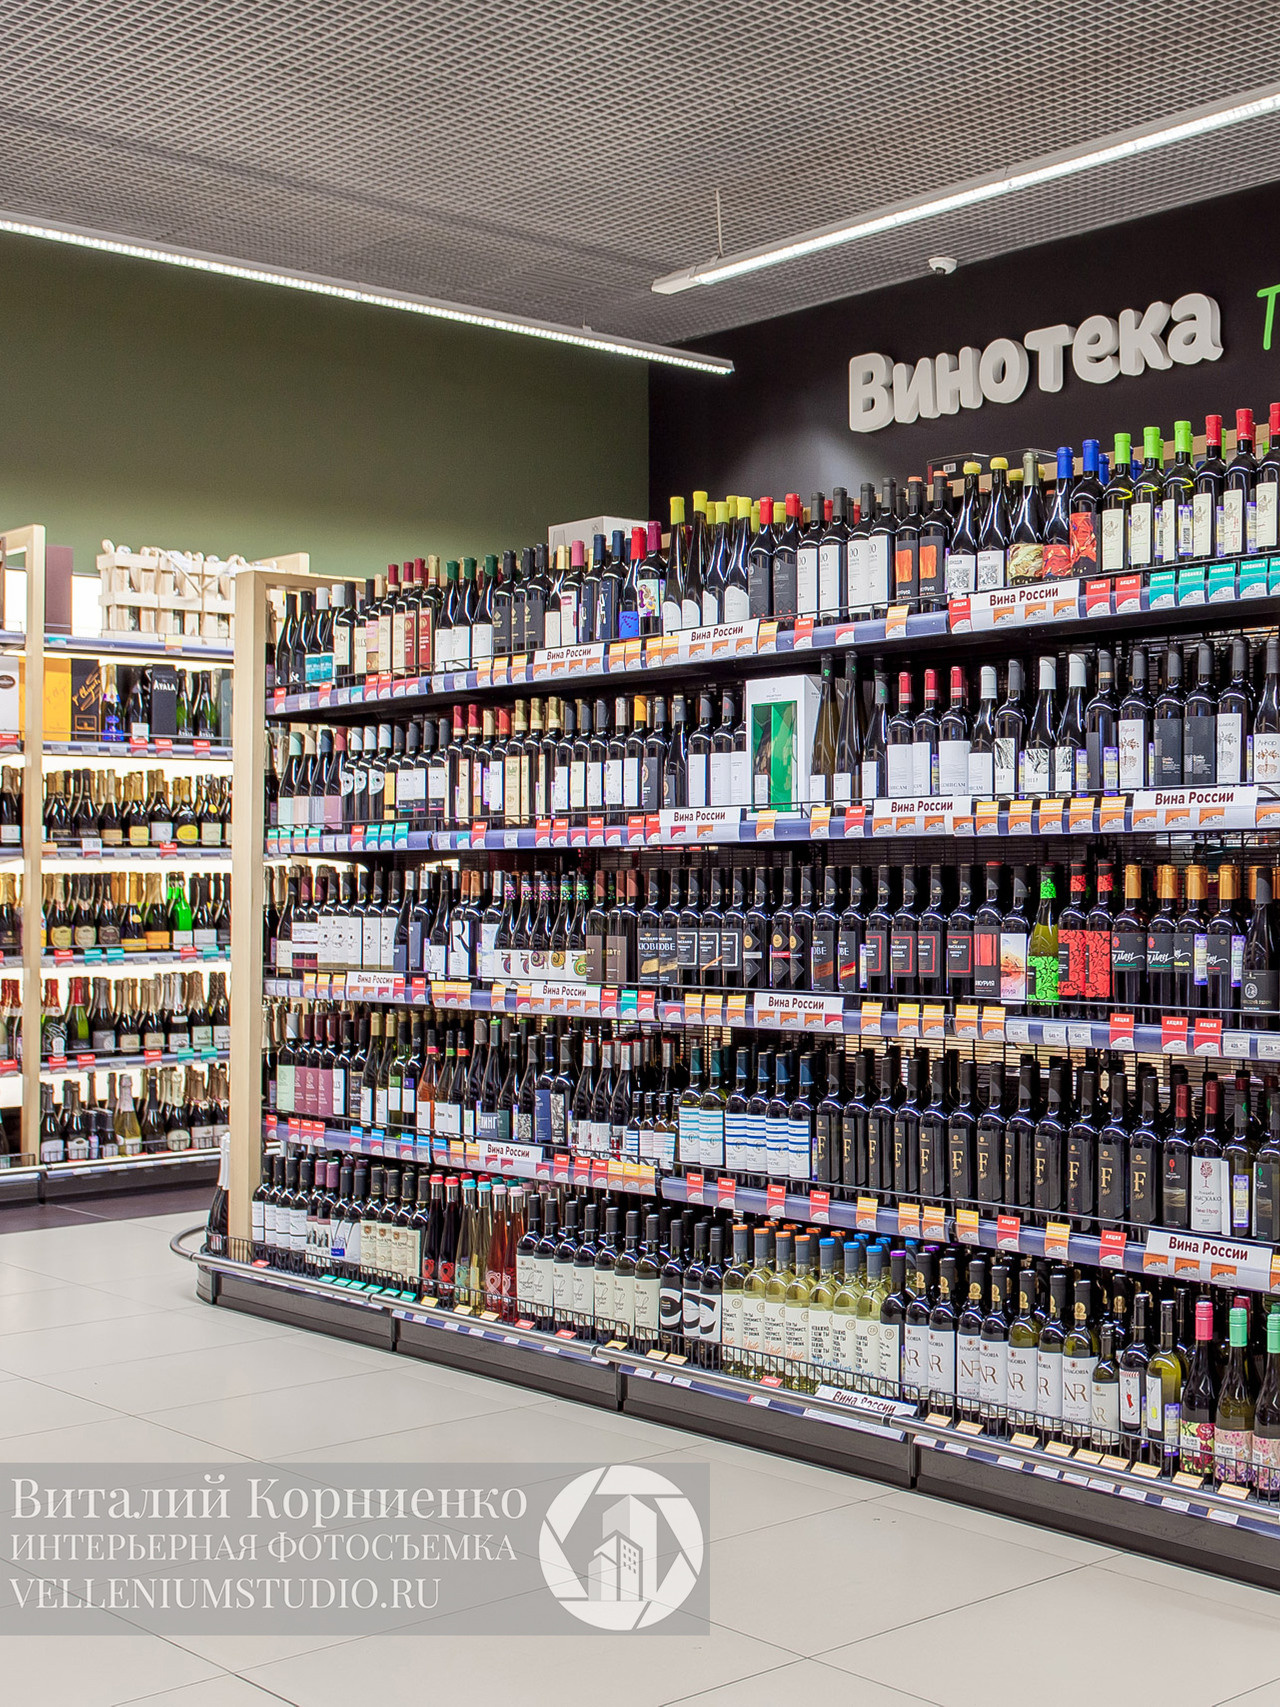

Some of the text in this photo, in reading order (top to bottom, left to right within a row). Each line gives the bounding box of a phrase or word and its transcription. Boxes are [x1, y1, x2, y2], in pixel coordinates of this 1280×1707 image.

[848, 292, 1225, 434] Винотека
[1119, 578, 1136, 586] АКЦИЯ
[989, 585, 1059, 607] Вина России
[690, 624, 744, 642] Вина России
[546, 648, 564, 660] Вина
[1154, 790, 1234, 806] Вина России
[890, 800, 953, 813] Вина России
[673, 810, 726, 822] Вина России
[542, 985, 587, 997] Вина России
[768, 996, 825, 1010] Вина России
[487, 1143, 530, 1159] Вина России
[1168, 1236, 1249, 1261] Вина России
